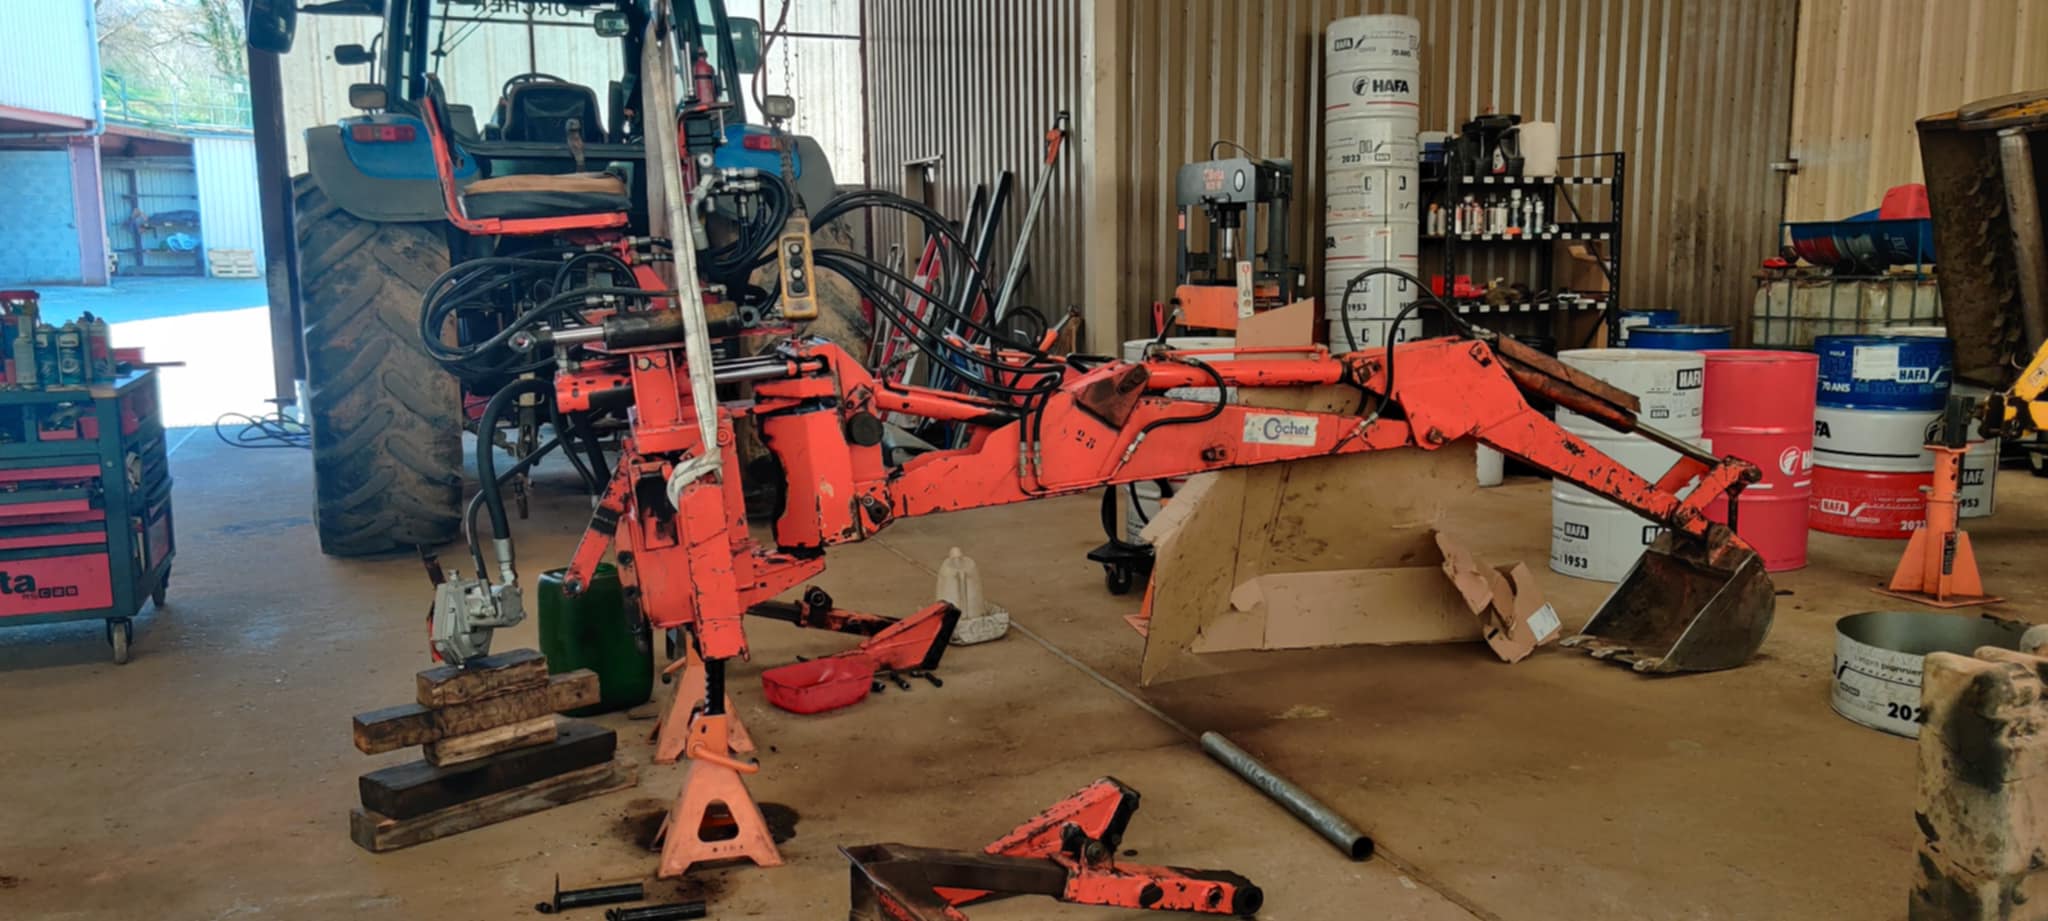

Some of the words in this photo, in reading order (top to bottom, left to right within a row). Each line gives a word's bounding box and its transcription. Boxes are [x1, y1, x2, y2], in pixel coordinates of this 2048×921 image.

[1372, 79, 1409, 94] HAFA
[1680, 370, 1702, 388] HAF
[1898, 368, 1926, 381] HAFA
[1822, 382, 1831, 391] 70
[1832, 383, 1851, 393] ANS
[1263, 417, 1309, 441] Cochet
[1815, 421, 1831, 438] FA
[1823, 501, 1846, 514] HAFA
[1961, 498, 1979, 508] 953
[1566, 524, 1587, 538] HAFA
[1564, 554, 1588, 569] 1953
[0, 571, 36, 594] ta
[1887, 702, 1924, 723] 202
